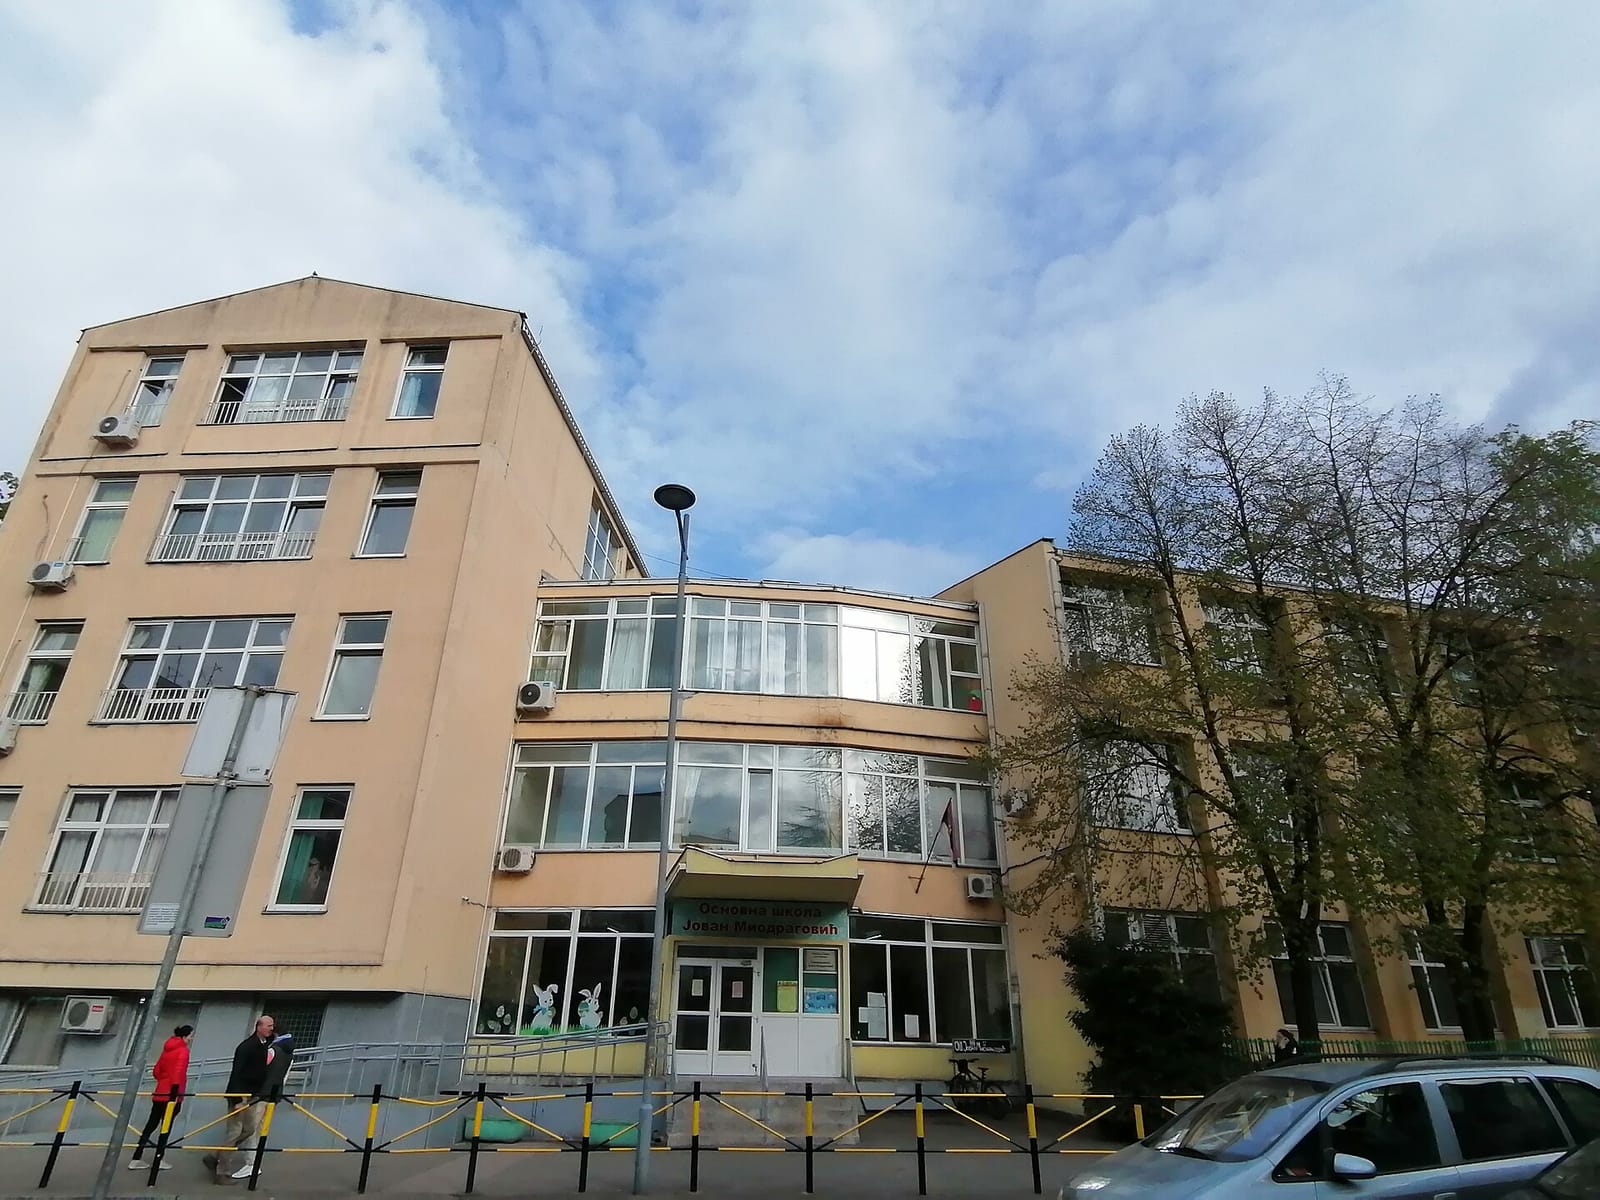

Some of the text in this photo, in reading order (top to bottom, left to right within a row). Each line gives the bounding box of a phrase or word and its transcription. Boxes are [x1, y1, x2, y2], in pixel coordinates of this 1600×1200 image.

[700, 902, 822, 918] Основна школа
[683, 919, 838, 936] Јован Миодраговић
